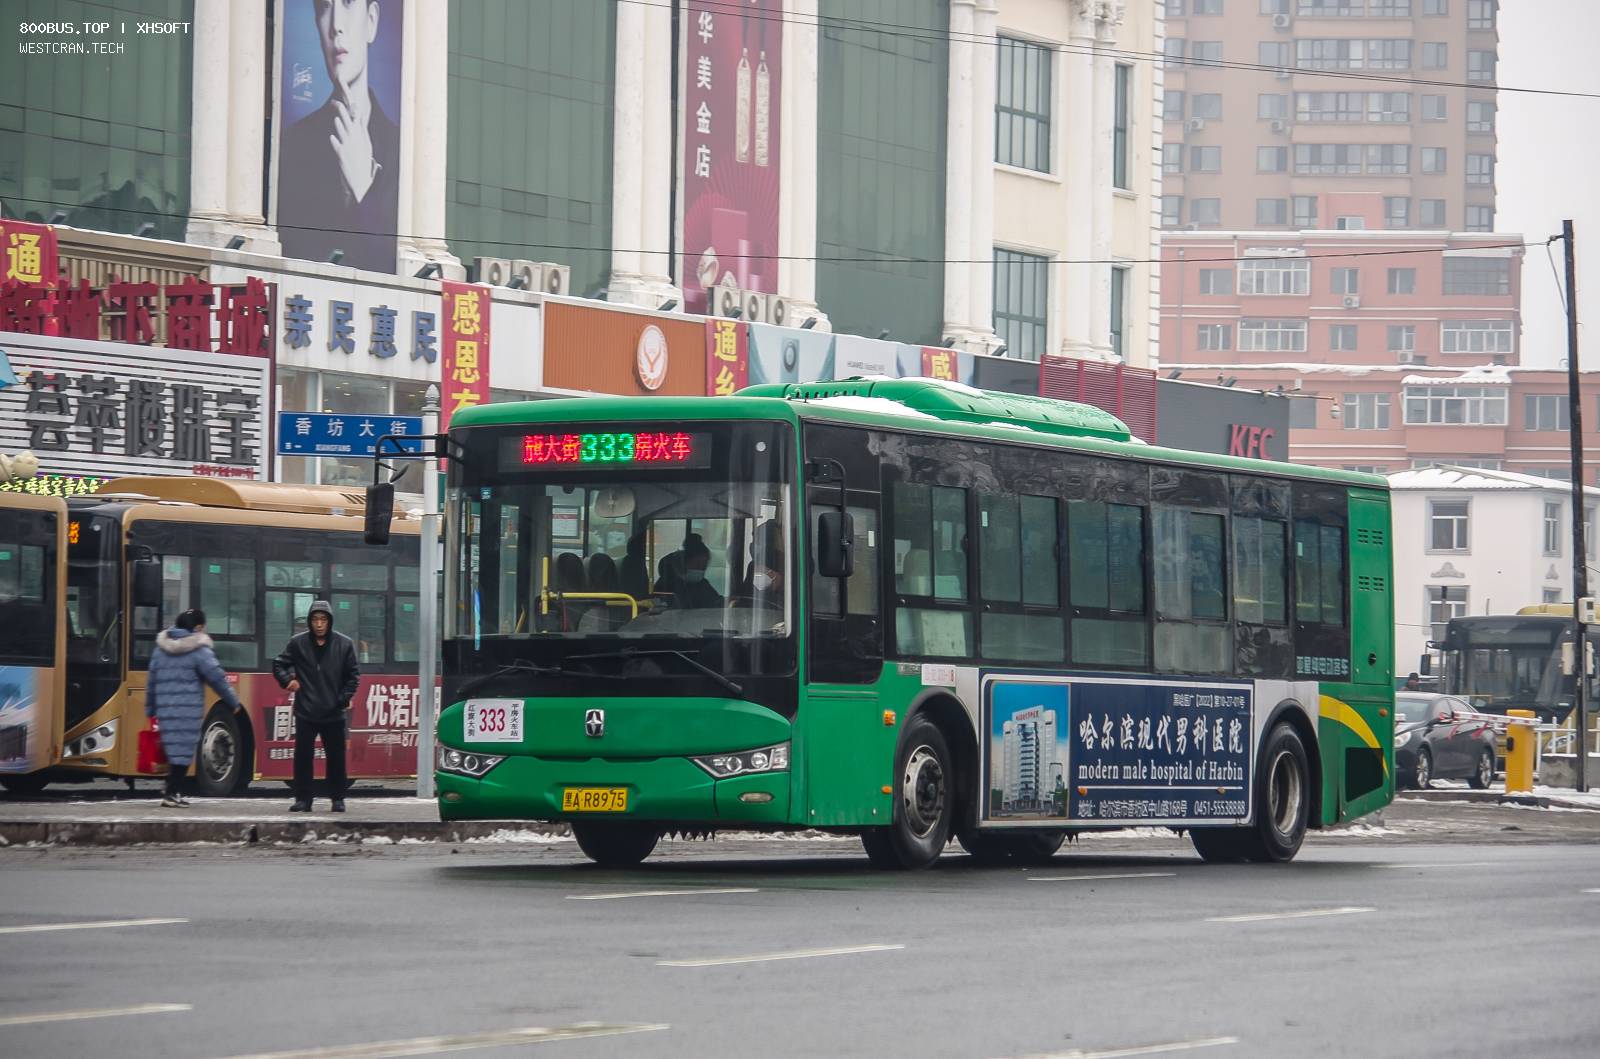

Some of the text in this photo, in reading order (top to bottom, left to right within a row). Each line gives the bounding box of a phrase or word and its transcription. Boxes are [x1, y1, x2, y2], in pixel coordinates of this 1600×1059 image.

[695, 11, 713, 178] 华美金店
[7, 234, 42, 283] 通
[284, 294, 437, 364] 亲民惠民
[295, 417, 407, 437] 香坊大街
[1230, 423, 1275, 459] KFC
[467, 705, 476, 736] 红旗大街
[479, 709, 505, 731] 333
[510, 704, 519, 736] 平房火车站
[1079, 713, 1243, 756] 哈尔滨现代男科医院
[1078, 759, 1243, 785] modern male hospital of Harbin
